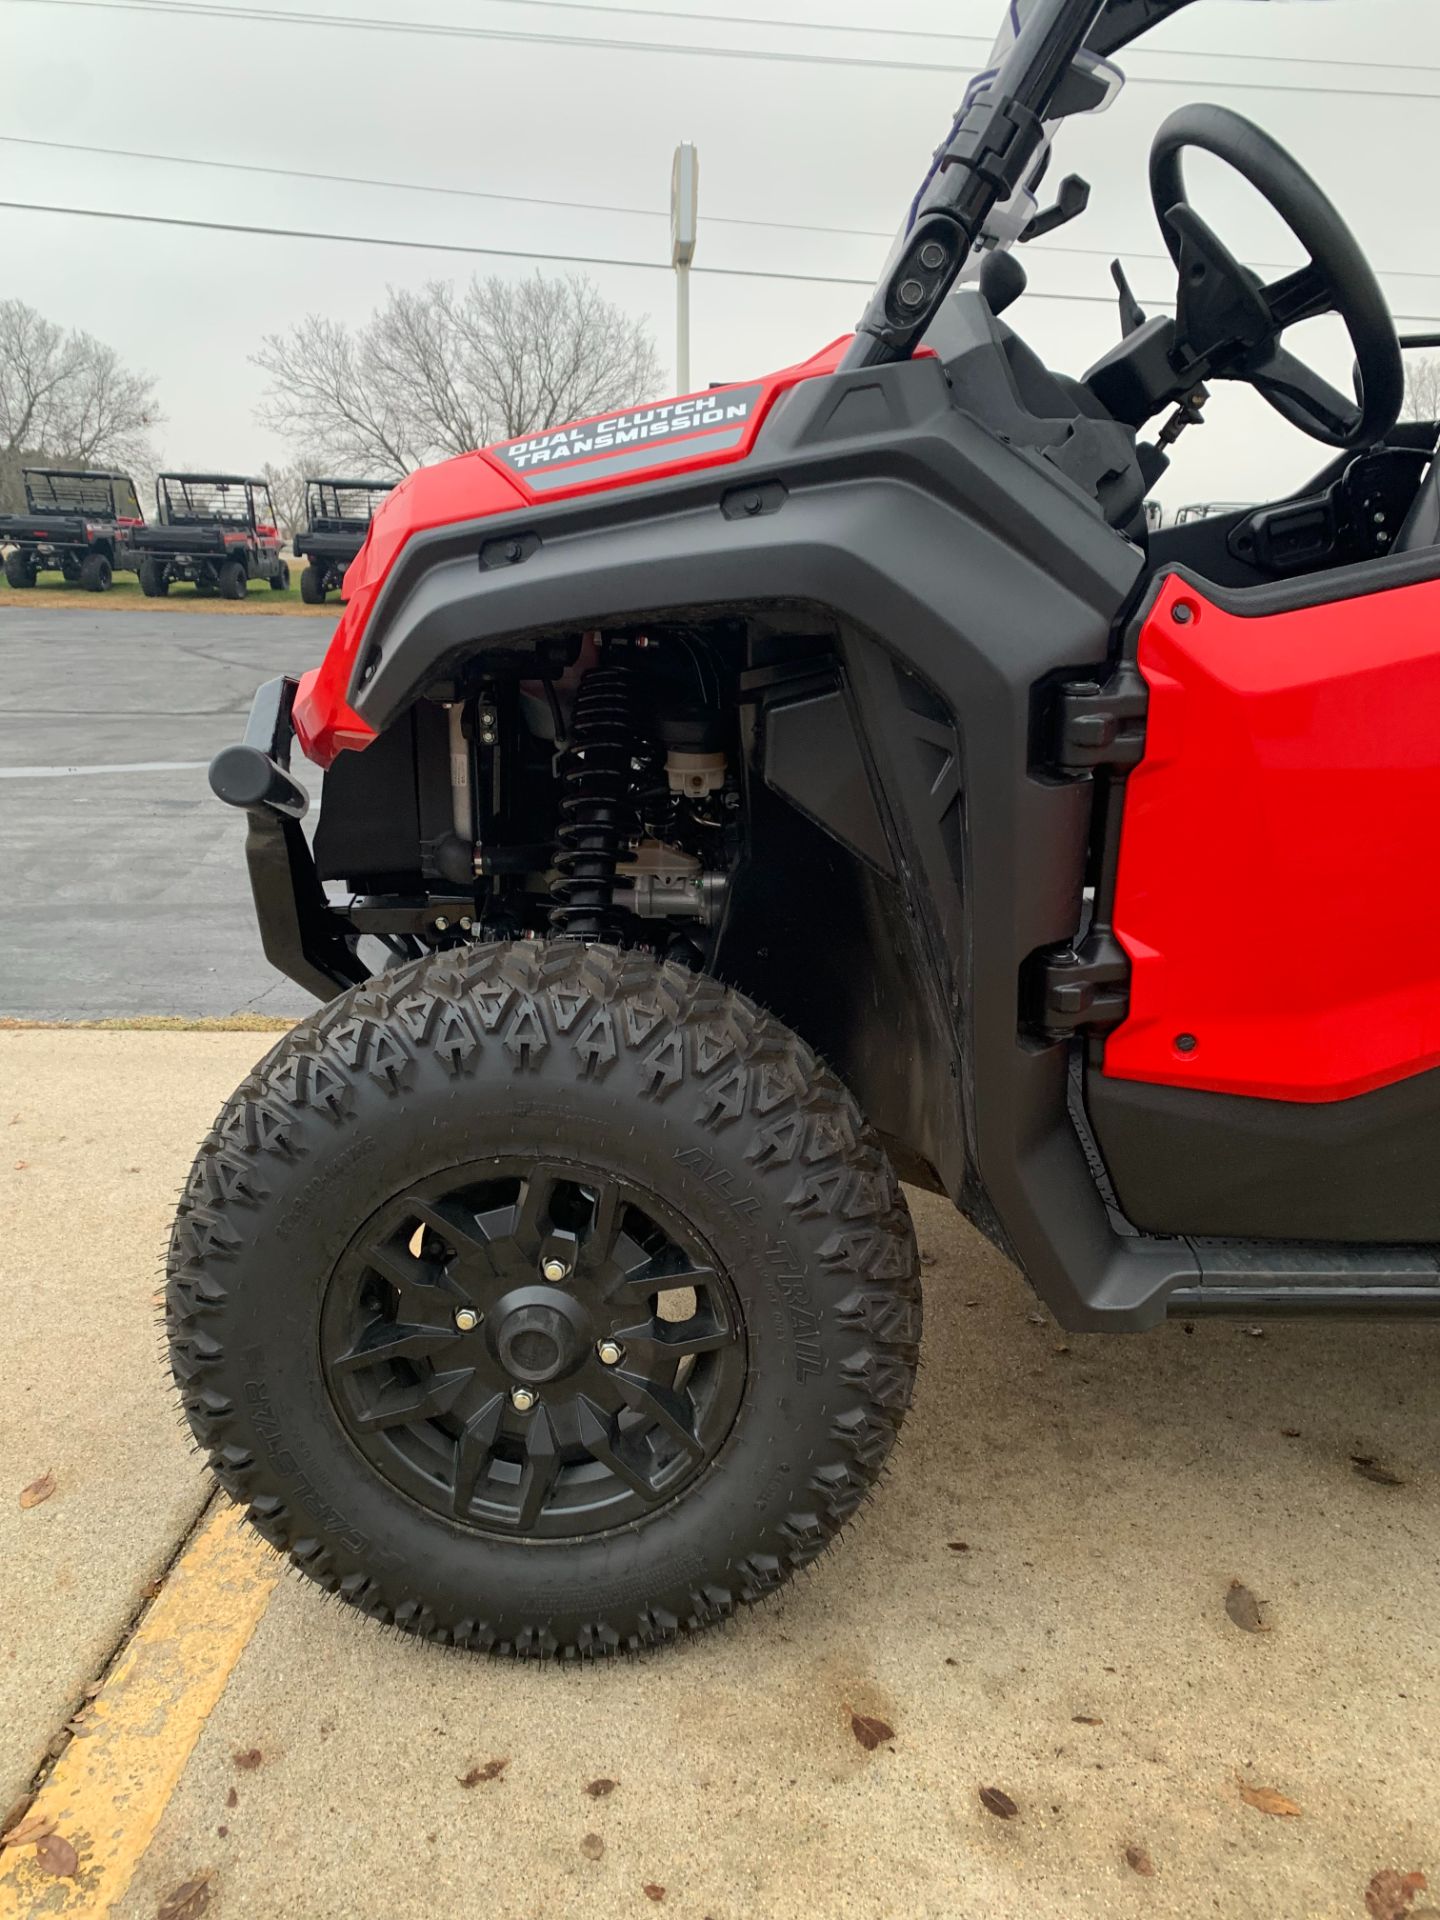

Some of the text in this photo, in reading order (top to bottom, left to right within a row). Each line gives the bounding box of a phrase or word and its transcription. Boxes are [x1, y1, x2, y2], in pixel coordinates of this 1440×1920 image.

[508, 396, 716, 457] DUAL CLUTCH
[514, 403, 747, 467] TRANSMISSION
[672, 1147, 762, 1228] ALL
[765, 1239, 826, 1386] TRAIL
[243, 1379, 370, 1555] CARLSTAR
